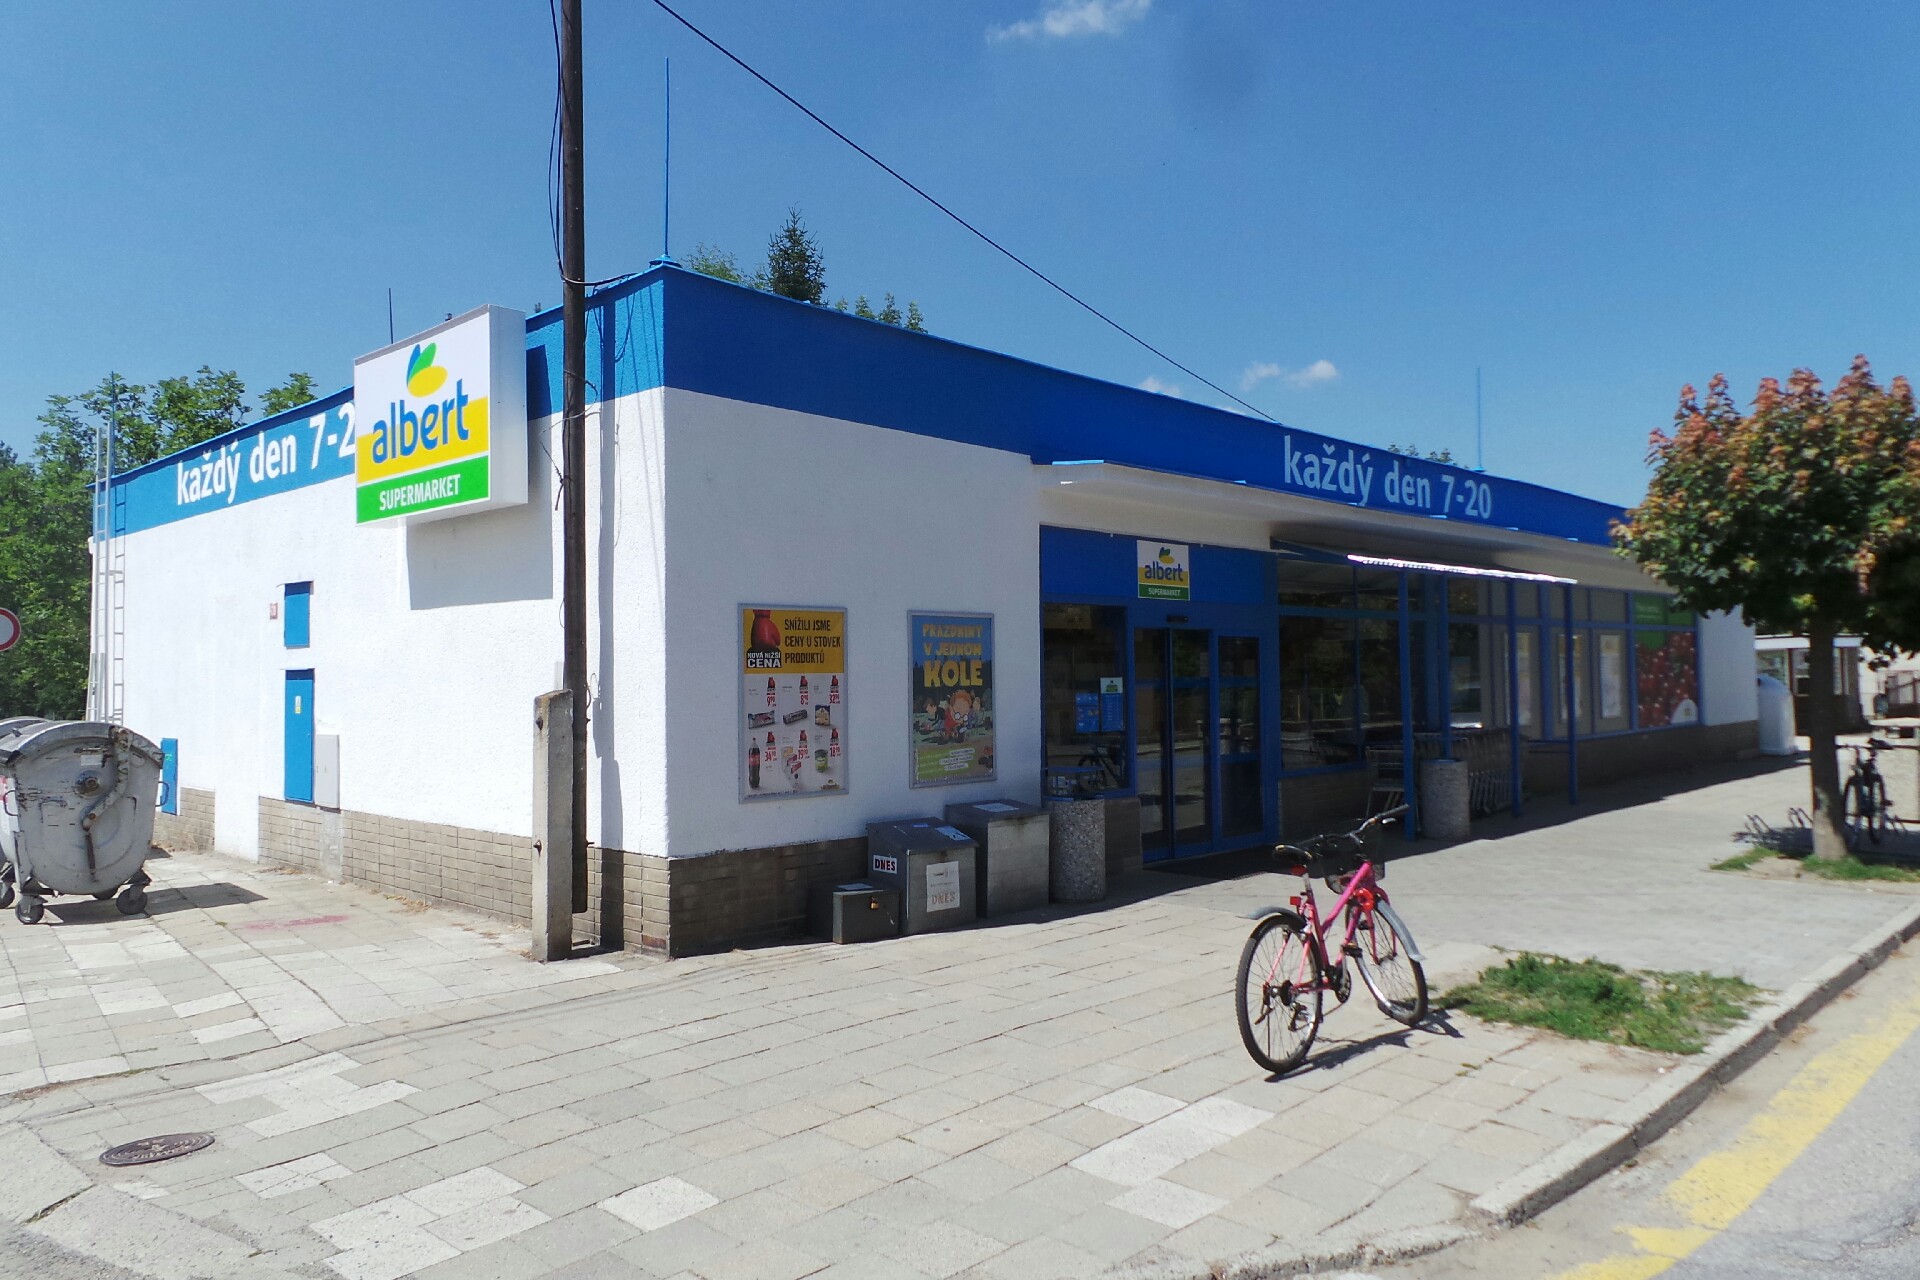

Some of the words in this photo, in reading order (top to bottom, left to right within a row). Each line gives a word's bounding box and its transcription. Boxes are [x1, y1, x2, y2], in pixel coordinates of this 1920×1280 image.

[372, 378, 469, 464] albert
[177, 438, 241, 506] každý
[250, 430, 297, 484] den
[309, 402, 356, 470] 7-2
[1284, 434, 1374, 507] každý
[1384, 460, 1431, 509] den
[1441, 474, 1492, 519] 7-20
[379, 474, 461, 511] SUPERMARKET
[1144, 561, 1184, 582] albert
[1148, 587, 1181, 597] SUPERMARKET
[812, 619, 831, 631] JSME
[784, 635, 804, 647] CENY
[806, 636, 812, 647] U
[814, 636, 840, 648] STOVEK
[924, 642, 932, 656] V
[747, 658, 781, 668] CENA
[923, 659, 983, 687] KOLE
[874, 858, 896, 872] DNES
